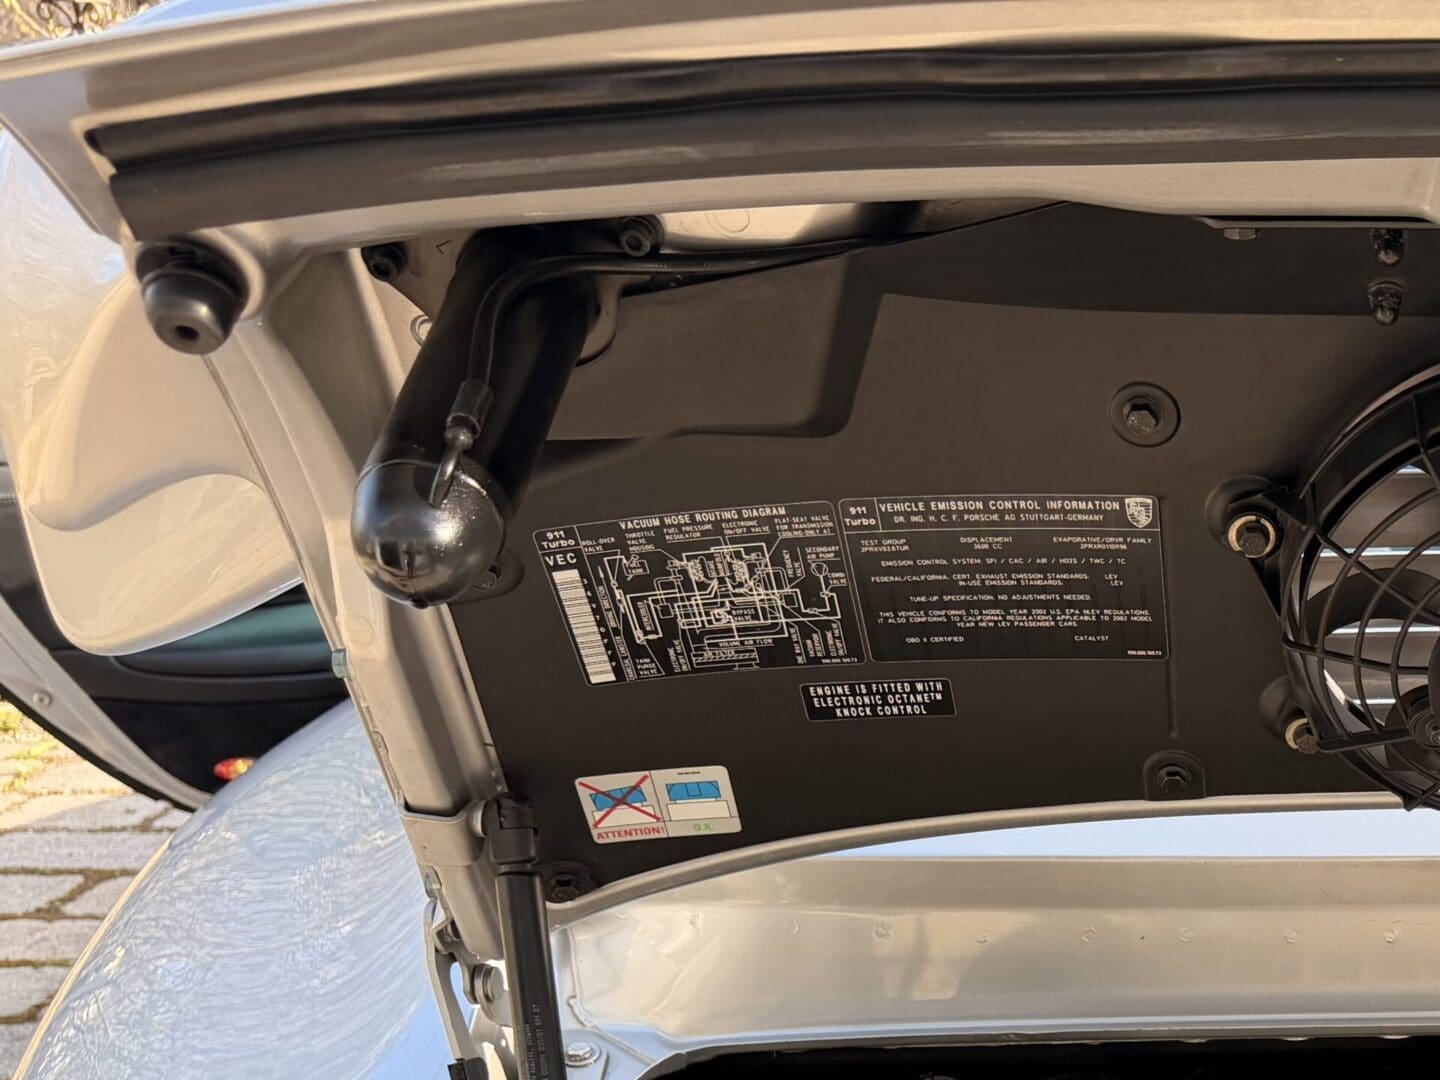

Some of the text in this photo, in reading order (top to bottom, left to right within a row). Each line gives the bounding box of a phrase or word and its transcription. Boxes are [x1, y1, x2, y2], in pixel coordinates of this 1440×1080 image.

[849, 506, 867, 515] 911
[879, 500, 1120, 512] VEHICLE EMISSION CONTROL INFORMATION
[619, 506, 787, 530] VACUUM HOSE ROUTING DIAGRAM
[810, 514, 830, 522] VALVE
[844, 517, 876, 526] Turbo
[893, 515, 907, 523] DR.
[910, 515, 926, 523] ING.
[963, 513, 1000, 522] PORSCHE
[1004, 513, 1016, 521] AG
[1020, 513, 1104, 522] STUTTGART-GERMANY
[682, 523, 714, 532] PRESSURE
[721, 520, 759, 529] ELECTRONIC
[791, 521, 834, 530] TRANSMISSION
[624, 530, 656, 539] THROTTLE
[723, 525, 770, 535] ON/OFF VALVE
[546, 530, 565, 540] 911
[664, 531, 701, 541] REGULATOR
[541, 539, 576, 550] Turbo
[581, 536, 616, 547] ROLL-OVER
[627, 538, 647, 546] VALVE
[882, 538, 907, 546] GROUP
[584, 544, 604, 553] VALVE
[628, 544, 656, 553] HOUSING
[804, 545, 839, 553] SECONDARY
[544, 552, 577, 567] VEC
[818, 552, 835, 560] PUMP
[881, 559, 914, 567] EMISSION
[916, 558, 948, 566] CONTROL
[829, 578, 847, 586] VALVE
[731, 608, 756, 616] BYPASS
[809, 681, 943, 697] ENGINE IS FITTED WITH
[813, 695, 882, 708] ELECTRONIC
[835, 704, 927, 718] KNOCK CONTROL
[596, 825, 665, 841] ATTENTION!
